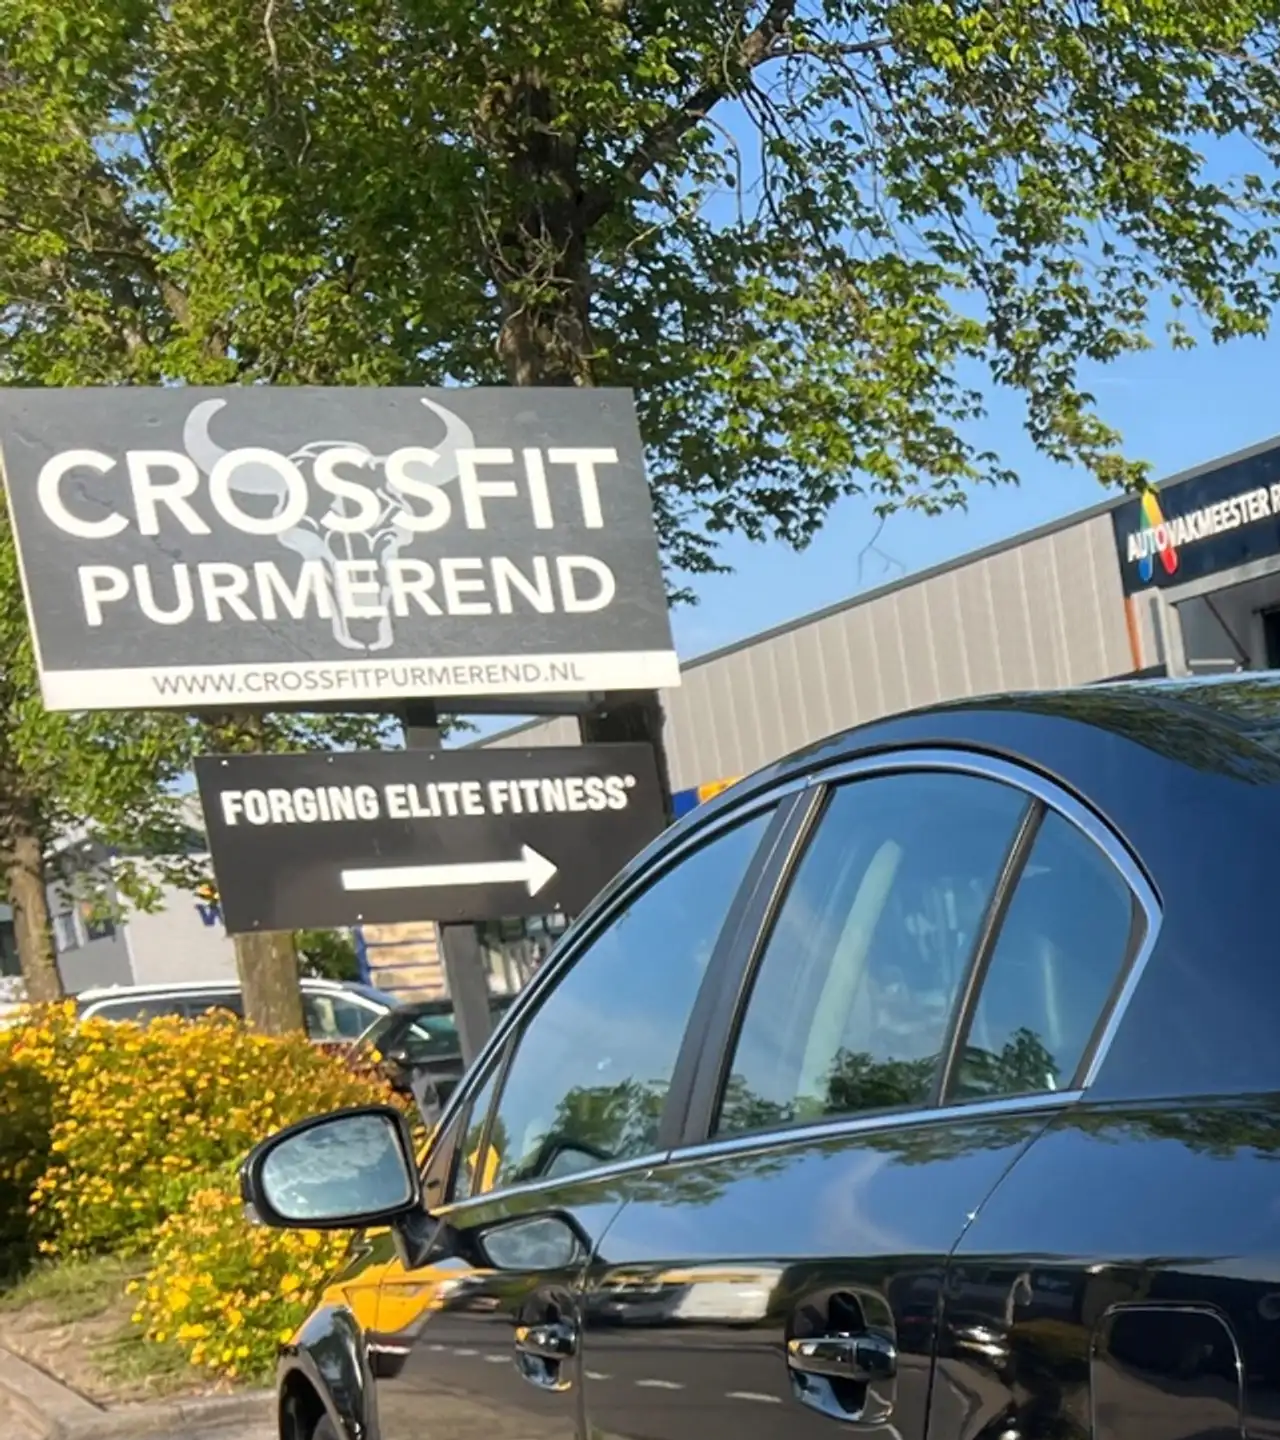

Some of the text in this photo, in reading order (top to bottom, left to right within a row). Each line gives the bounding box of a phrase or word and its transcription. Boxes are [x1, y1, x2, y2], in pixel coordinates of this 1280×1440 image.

[37, 446, 618, 538] CROSSFIT
[1127, 487, 1271, 562] AUTOVAKMEESTER
[78, 556, 616, 625] PURMEREND
[152, 662, 586, 695] WWW.CROSSFITPURMEREND.NL
[221, 785, 378, 826] FORGING
[385, 781, 482, 820] ELITE
